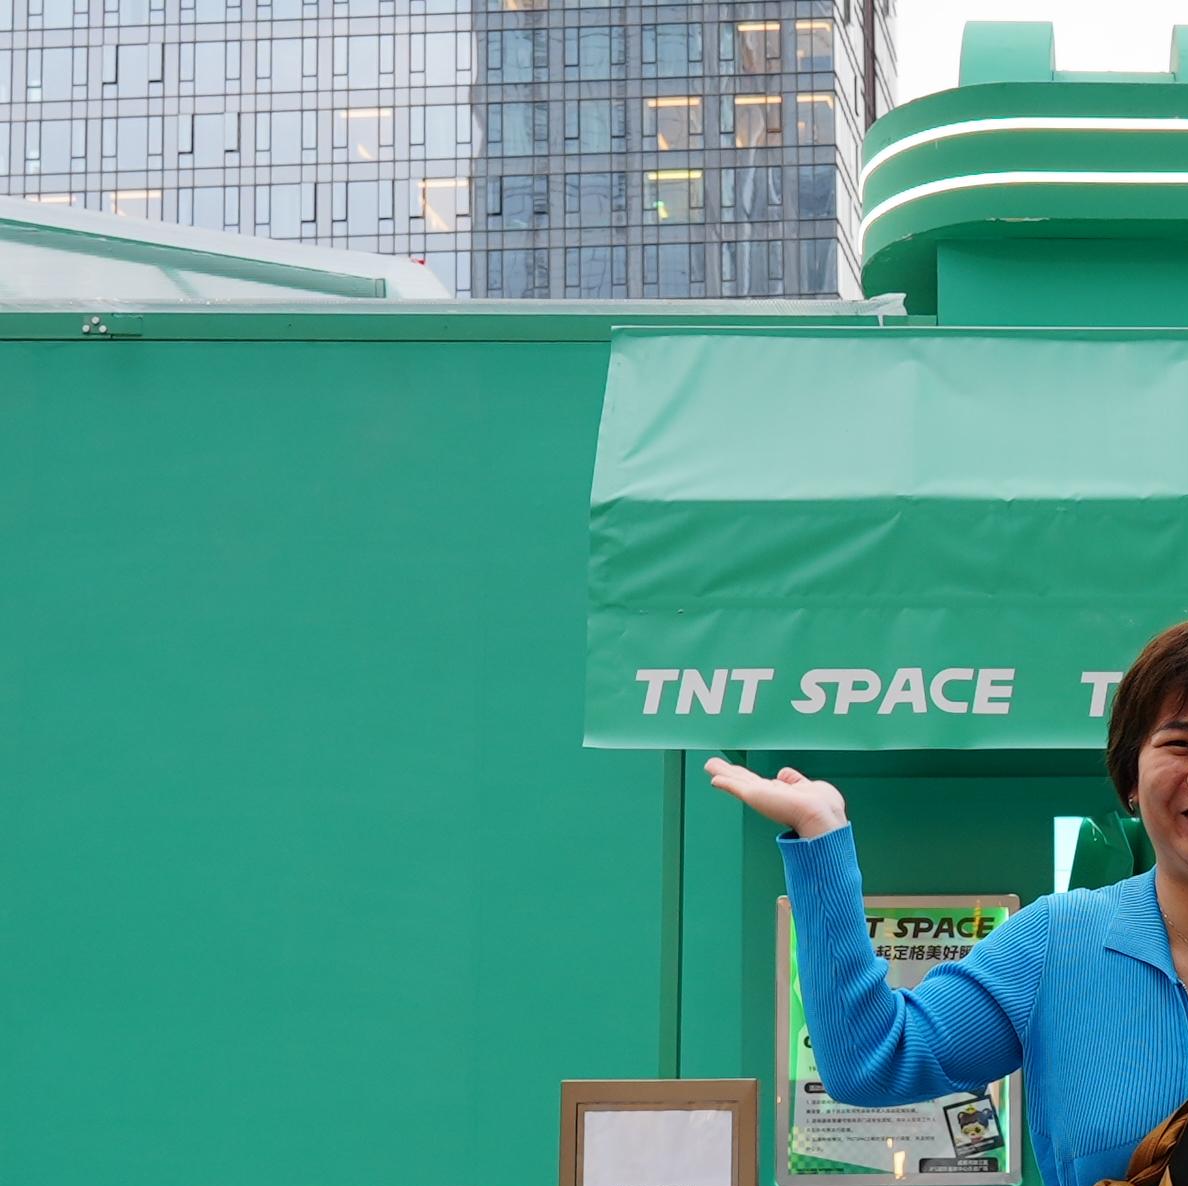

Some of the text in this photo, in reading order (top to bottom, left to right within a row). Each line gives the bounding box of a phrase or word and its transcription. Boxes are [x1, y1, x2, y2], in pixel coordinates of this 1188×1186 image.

[634, 668, 1016, 715] TNT SPACE
[893, 917, 996, 939] SPACE
